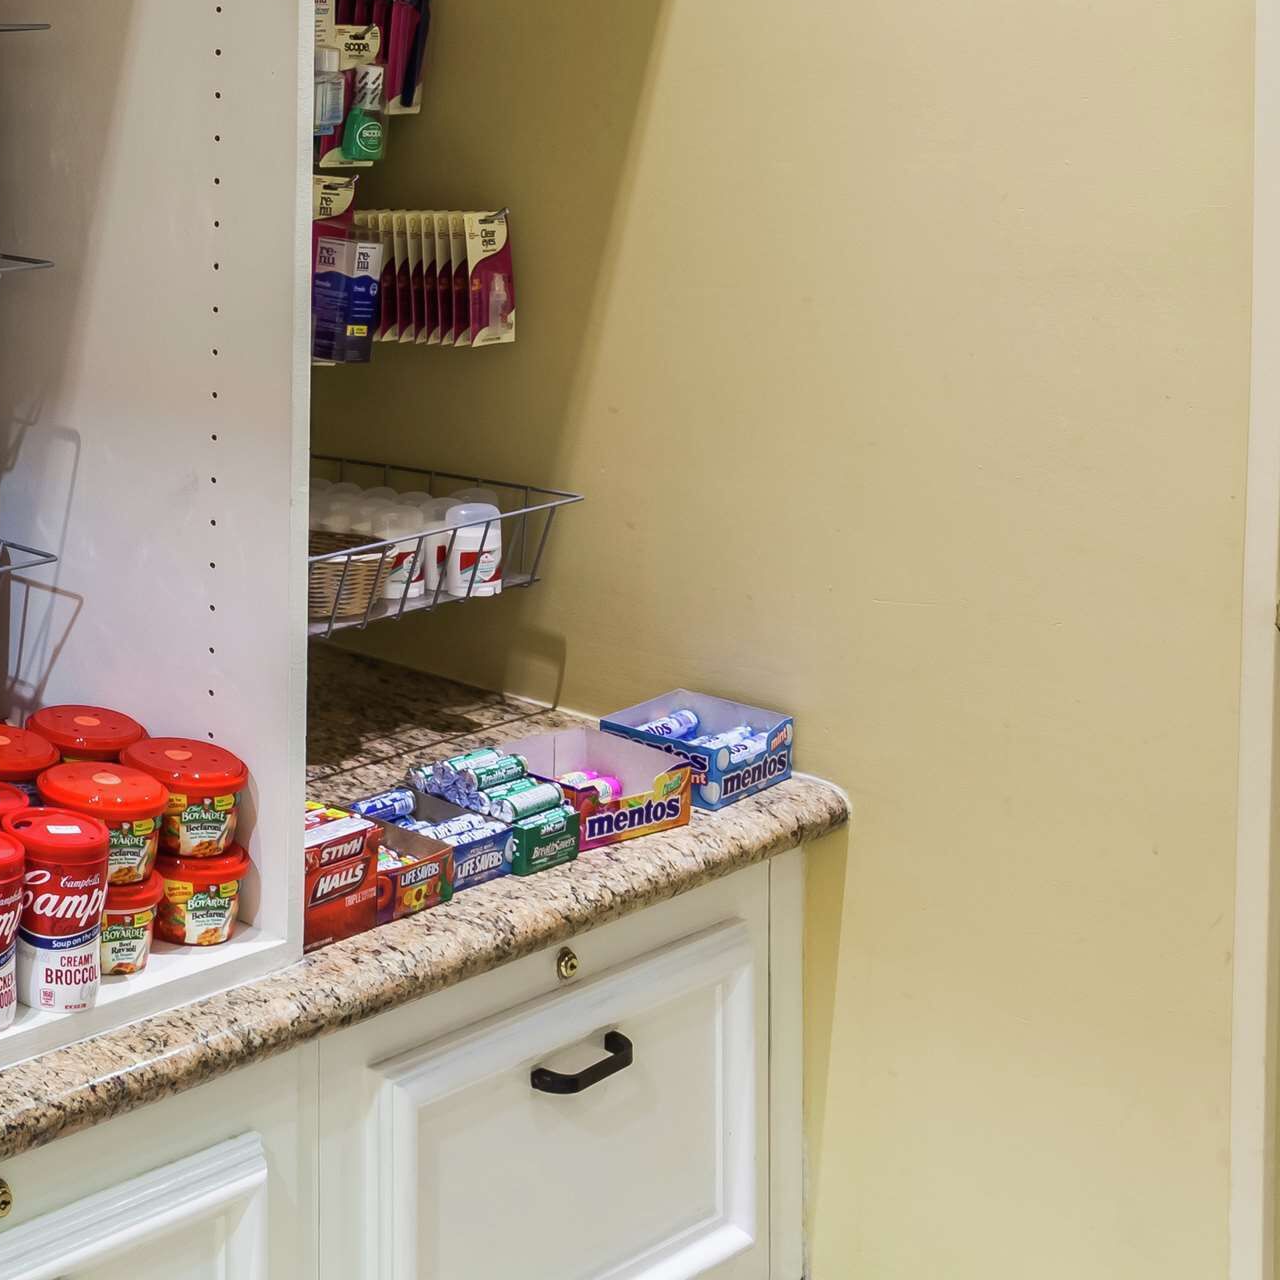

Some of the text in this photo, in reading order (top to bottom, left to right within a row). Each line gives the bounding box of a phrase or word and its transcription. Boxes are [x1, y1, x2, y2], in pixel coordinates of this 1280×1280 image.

[770, 728, 787, 751] mint
[721, 751, 788, 797] mentos
[182, 808, 225, 821] BOYARDEE
[587, 796, 681, 839] mentos
[186, 823, 222, 833] Beefaroni
[321, 837, 363, 862] HALLS
[456, 851, 503, 879] LIFE SAVERS
[316, 863, 365, 898] HALLS
[400, 862, 440, 887] LIFE SAVERS
[188, 896, 230, 910] BOYARDEE
[345, 893, 361, 907] TRIPLE
[191, 910, 226, 921] Beefaroni
[102, 927, 145, 940] BOYARDEE
[52, 939, 72, 950] Soup
[72, 937, 82, 945] on
[119, 939, 132, 948] Beef
[60, 953, 93, 968] CREAMY
